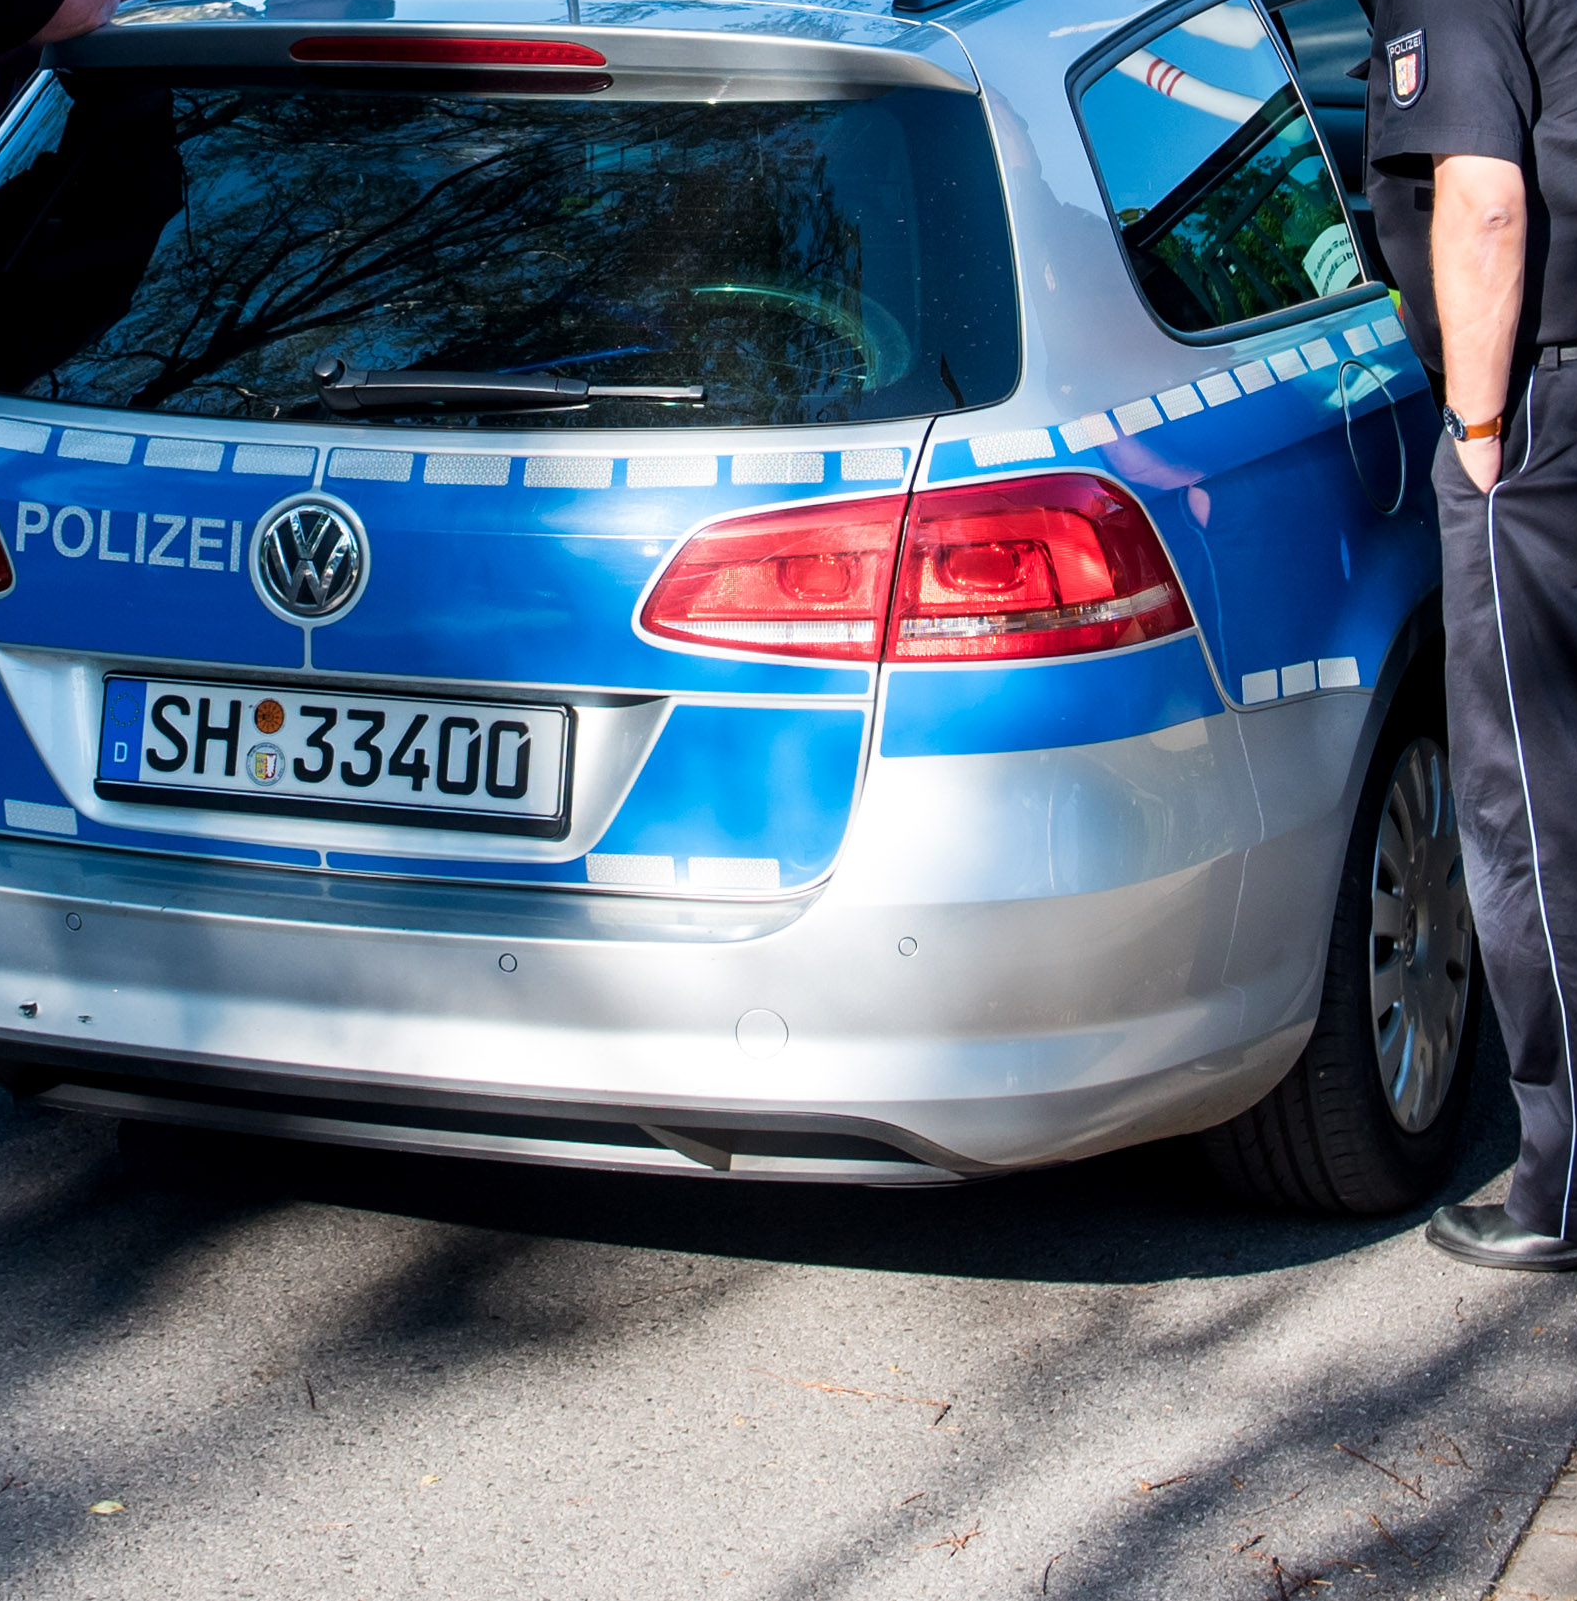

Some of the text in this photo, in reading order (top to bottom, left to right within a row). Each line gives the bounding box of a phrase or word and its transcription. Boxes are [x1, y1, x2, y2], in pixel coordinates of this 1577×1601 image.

[1390, 36, 1421, 57] POLIZEI
[15, 500, 243, 573] POLIZEI
[114, 741, 128, 763] D
[146, 694, 242, 777] SH
[293, 705, 532, 800] 33400
